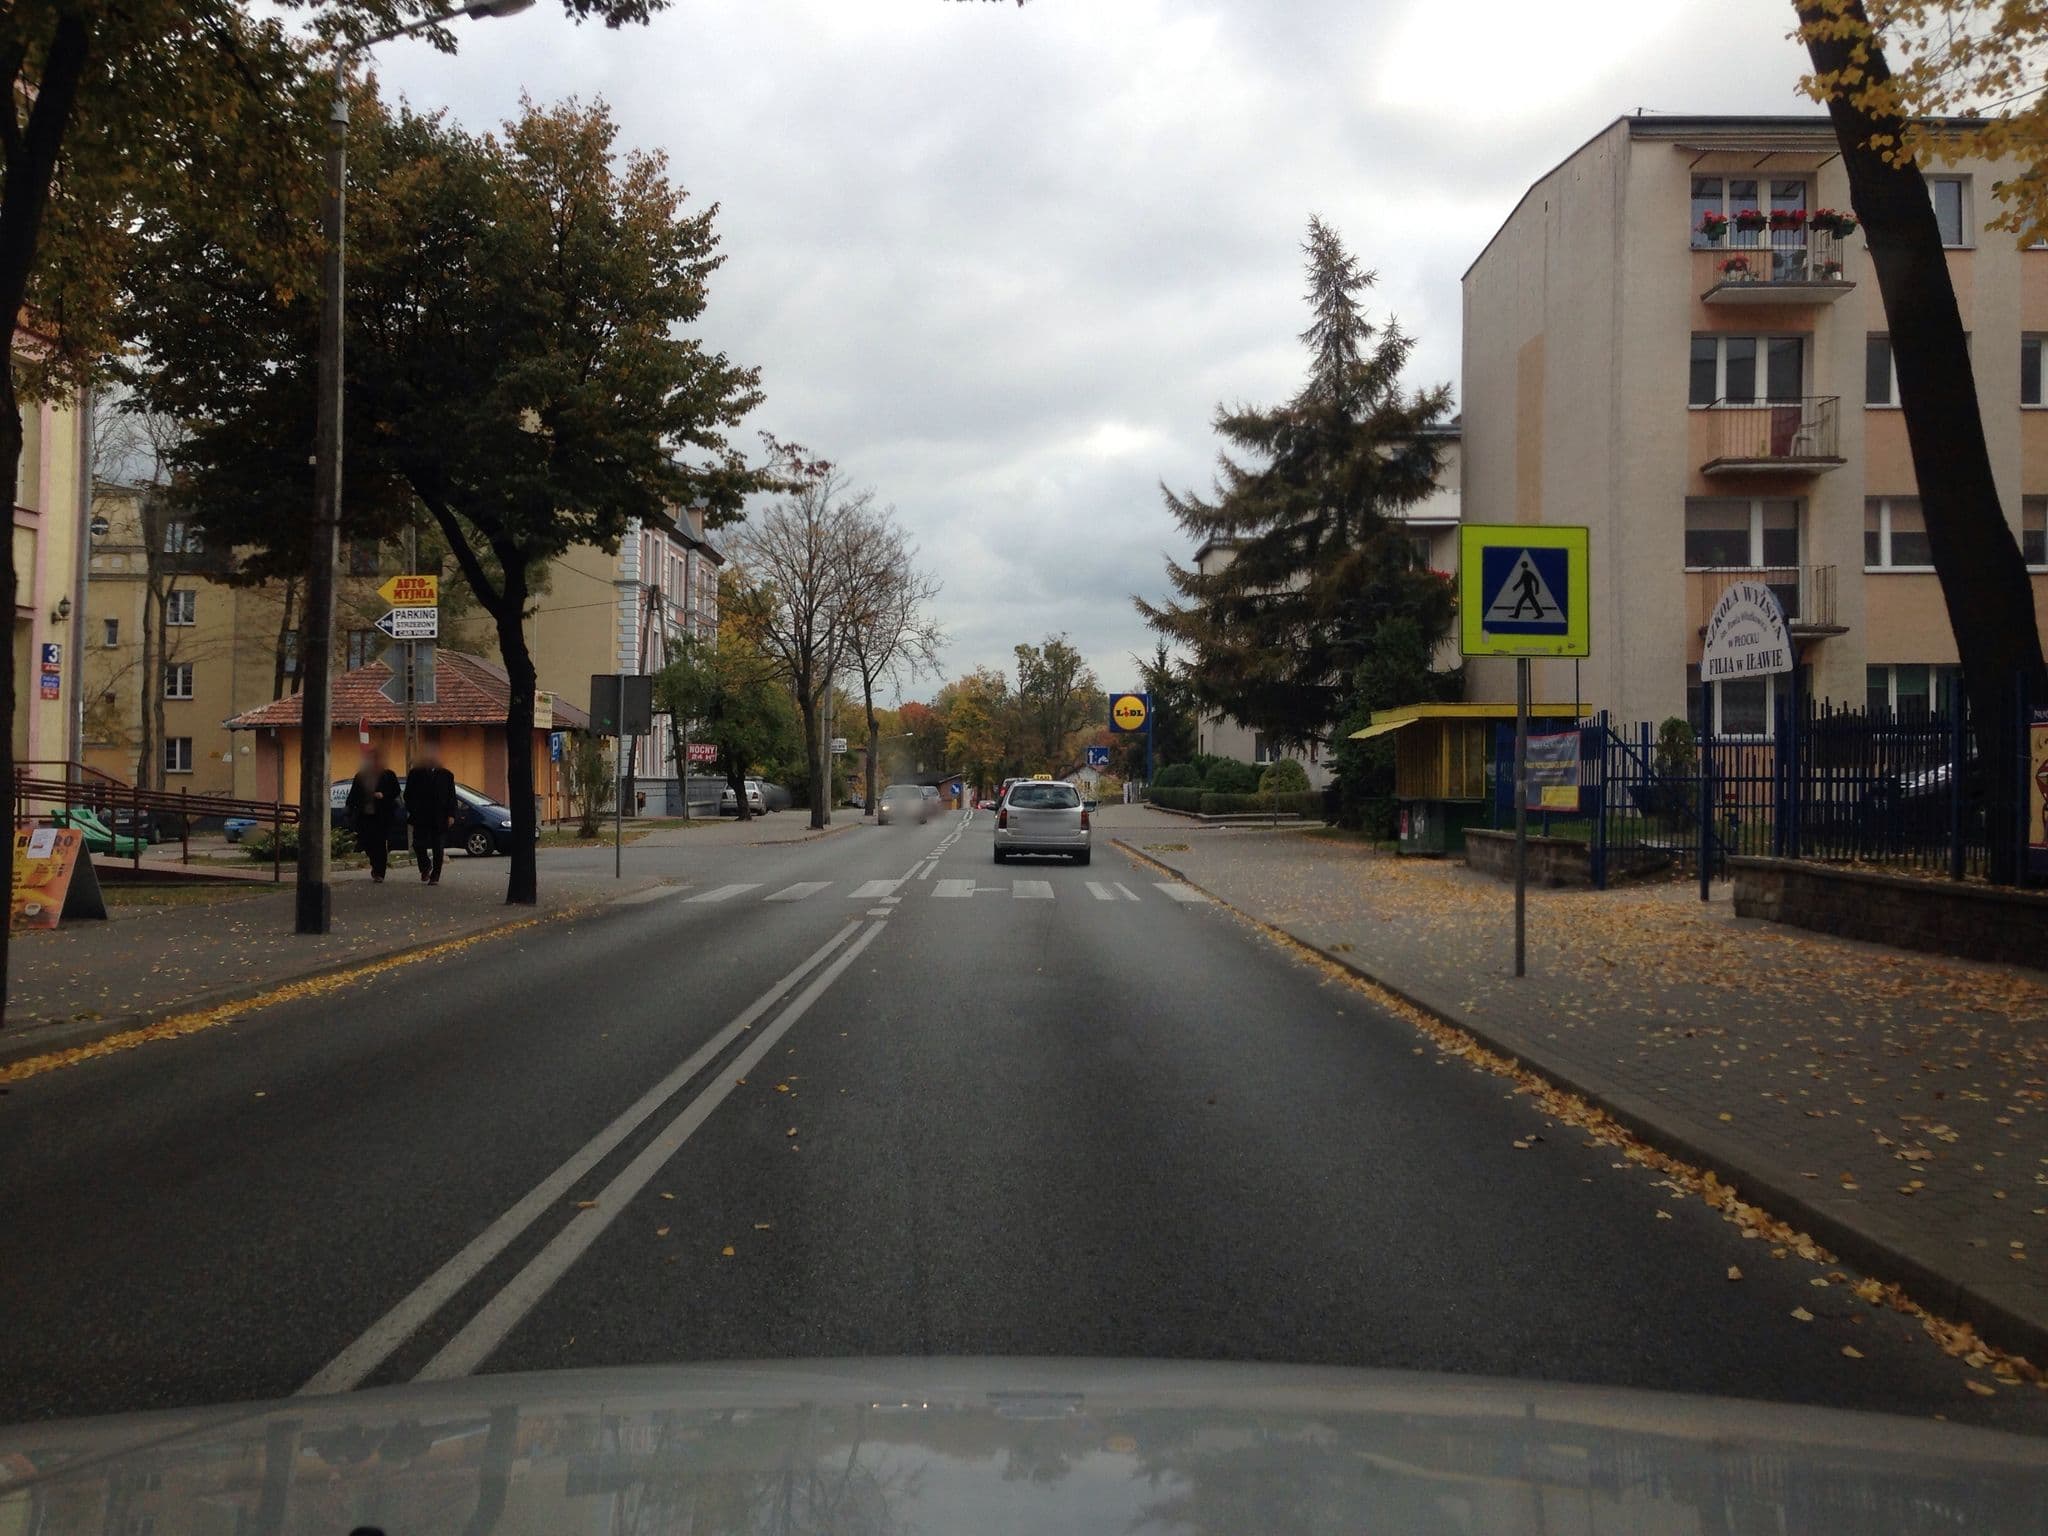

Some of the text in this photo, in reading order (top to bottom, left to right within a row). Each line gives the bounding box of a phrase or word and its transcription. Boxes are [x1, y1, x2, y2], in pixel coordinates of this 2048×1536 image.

[395, 610, 436, 619] PARKING
[1709, 648, 1783, 675] FILIA w IŁAWIE
[689, 745, 715, 754] NOCNY
